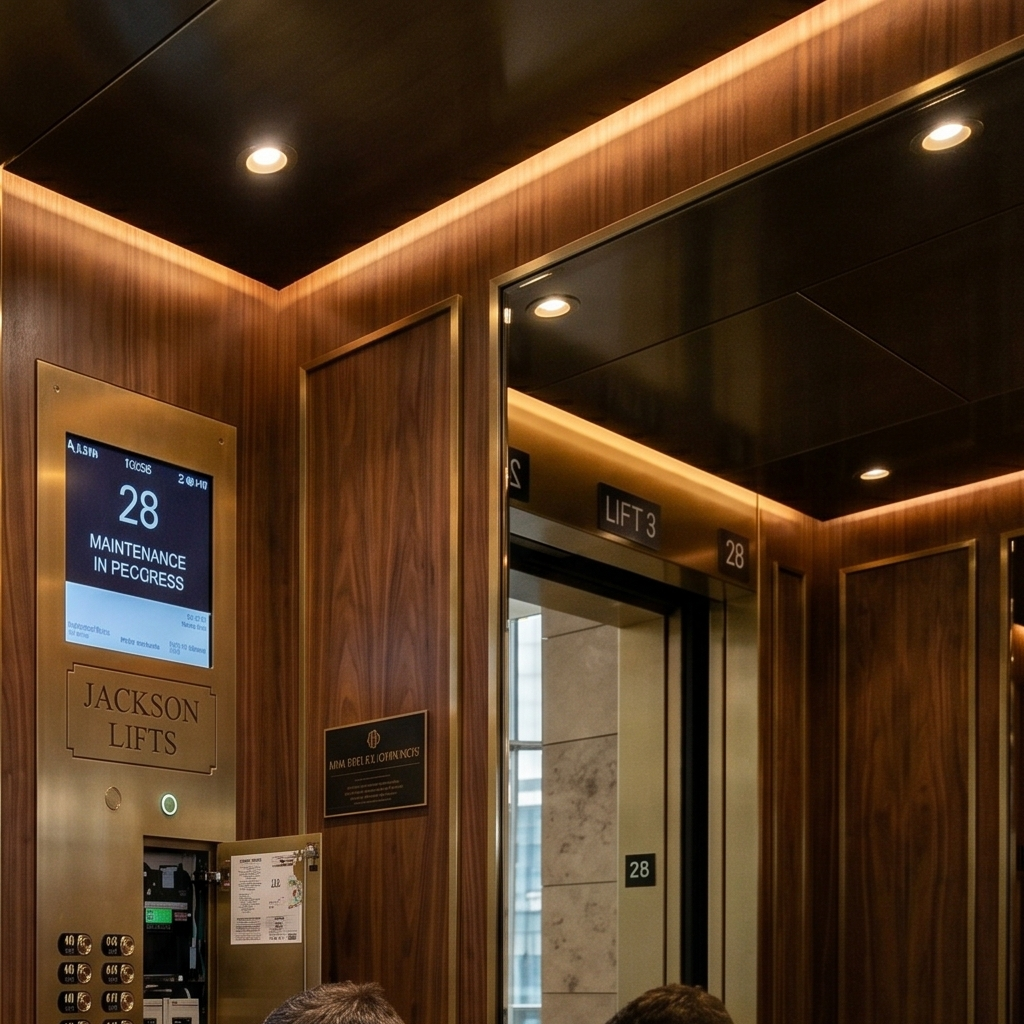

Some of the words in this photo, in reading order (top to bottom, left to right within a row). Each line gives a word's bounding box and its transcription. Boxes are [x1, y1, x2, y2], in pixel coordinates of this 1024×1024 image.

[119, 484, 159, 530] 28
[605, 495, 643, 531] LIFT
[646, 512, 656, 538] 3
[90, 533, 187, 571] MAINTENANCE
[94, 556, 107, 573] IN
[726, 539, 745, 569] 28
[83, 682, 199, 723] JACKSON
[108, 722, 177, 755] LIFTS
[630, 860, 650, 878] 28
